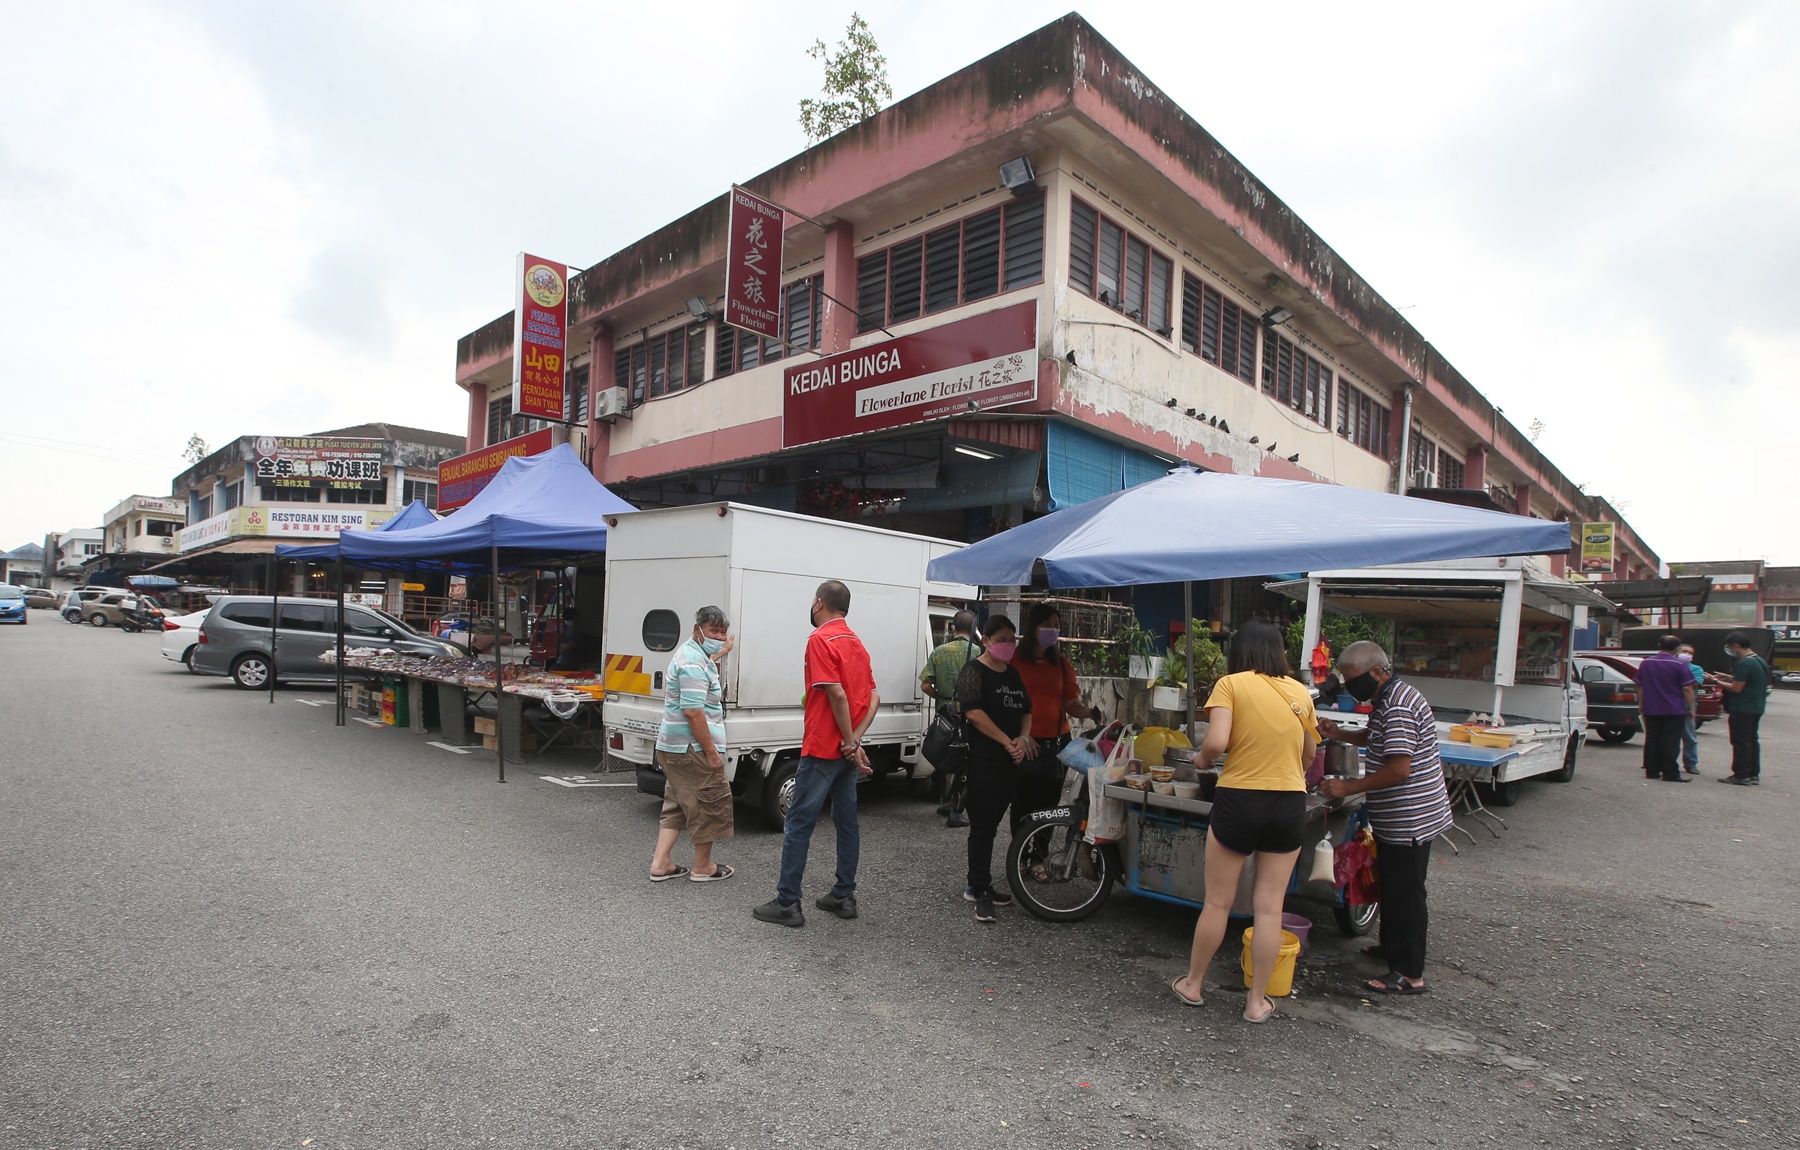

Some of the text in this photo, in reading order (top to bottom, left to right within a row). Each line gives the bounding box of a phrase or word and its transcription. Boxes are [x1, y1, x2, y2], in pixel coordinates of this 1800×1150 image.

[736, 193, 780, 221] KEDAI BUNGA
[732, 298, 775, 322] Flowerlane
[740, 313, 766, 330] Florist
[525, 346, 561, 373] 山田
[790, 348, 902, 396] KEDAI BUNGA
[522, 383, 561, 400] PERNIAGAAN
[525, 395, 559, 411] SHAN TYAN
[860, 375, 974, 414] Flowerlane Florist
[257, 457, 381, 481] 全年免费功课班
[461, 456, 489, 477] BARANGAN
[271, 512, 319, 523] RESTORAN
[321, 514, 338, 524] KIM
[341, 515, 363, 525] SING
